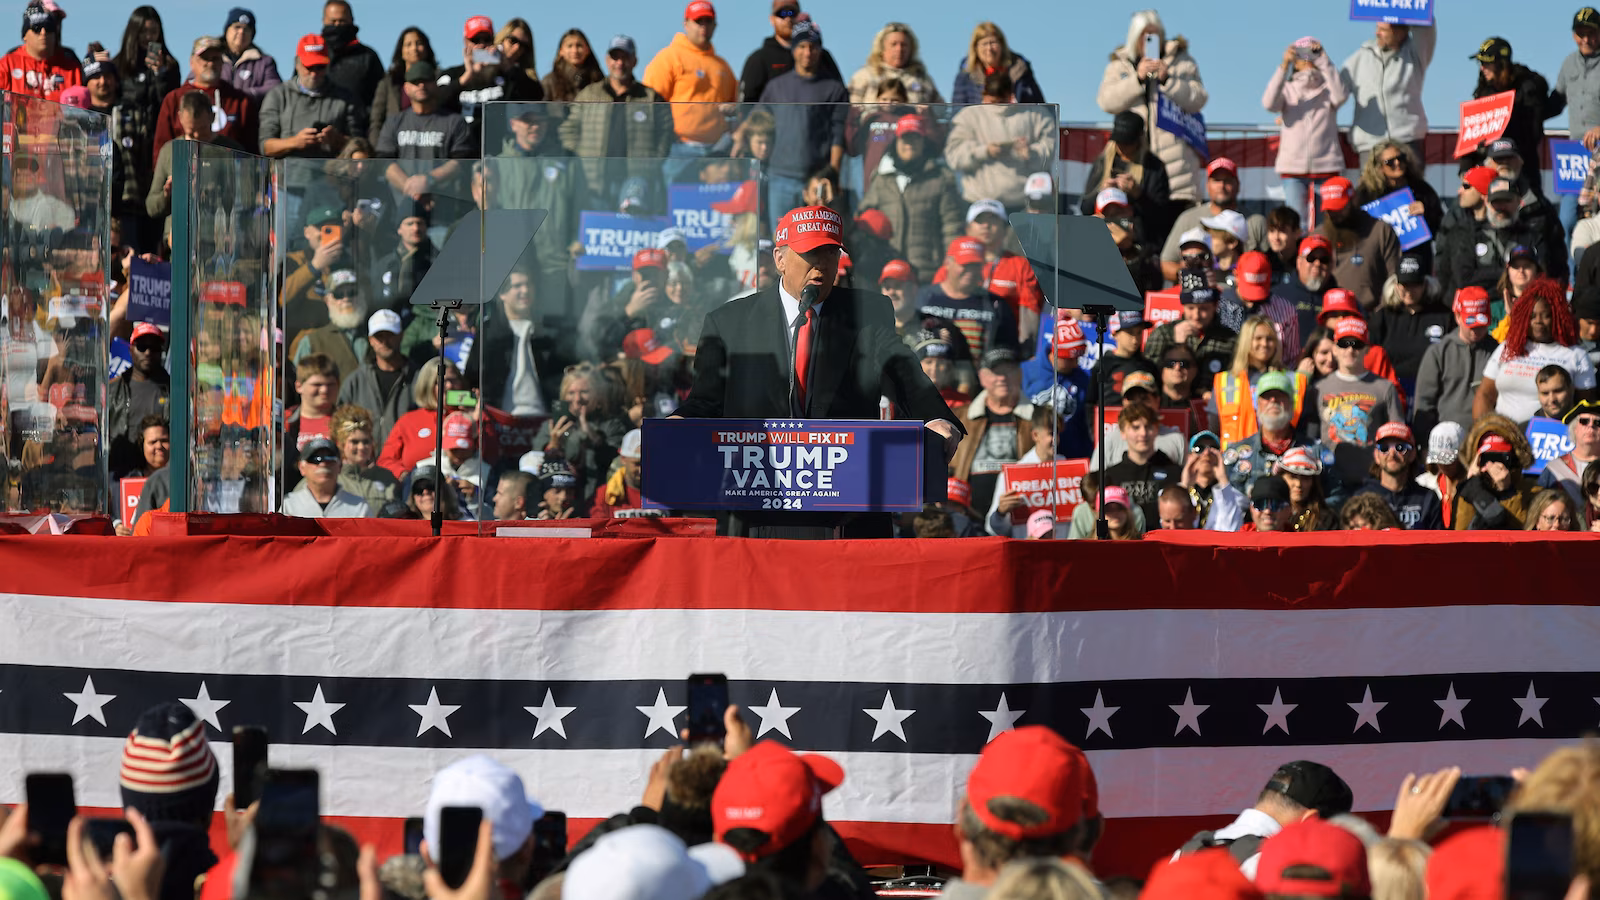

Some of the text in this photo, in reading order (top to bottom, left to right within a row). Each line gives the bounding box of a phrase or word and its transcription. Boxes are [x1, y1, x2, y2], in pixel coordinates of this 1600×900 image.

[1463, 118, 1505, 142] AGAIN!
[792, 210, 814, 222] MAKE
[797, 221, 821, 234] GREAT
[585, 244, 621, 257] WILL
[132, 274, 171, 298] TRUMP
[131, 292, 149, 307] WILL
[1151, 308, 1181, 321] DRE
[718, 432, 848, 444] TRUMP WILL FIX IT
[717, 445, 849, 470] TRUMP
[731, 469, 833, 489] VANCE
[1057, 476, 1082, 490] BIG
[725, 489, 840, 498] MAKE AMERICA GREAT AGAIN!
[762, 498, 803, 510] 2024
